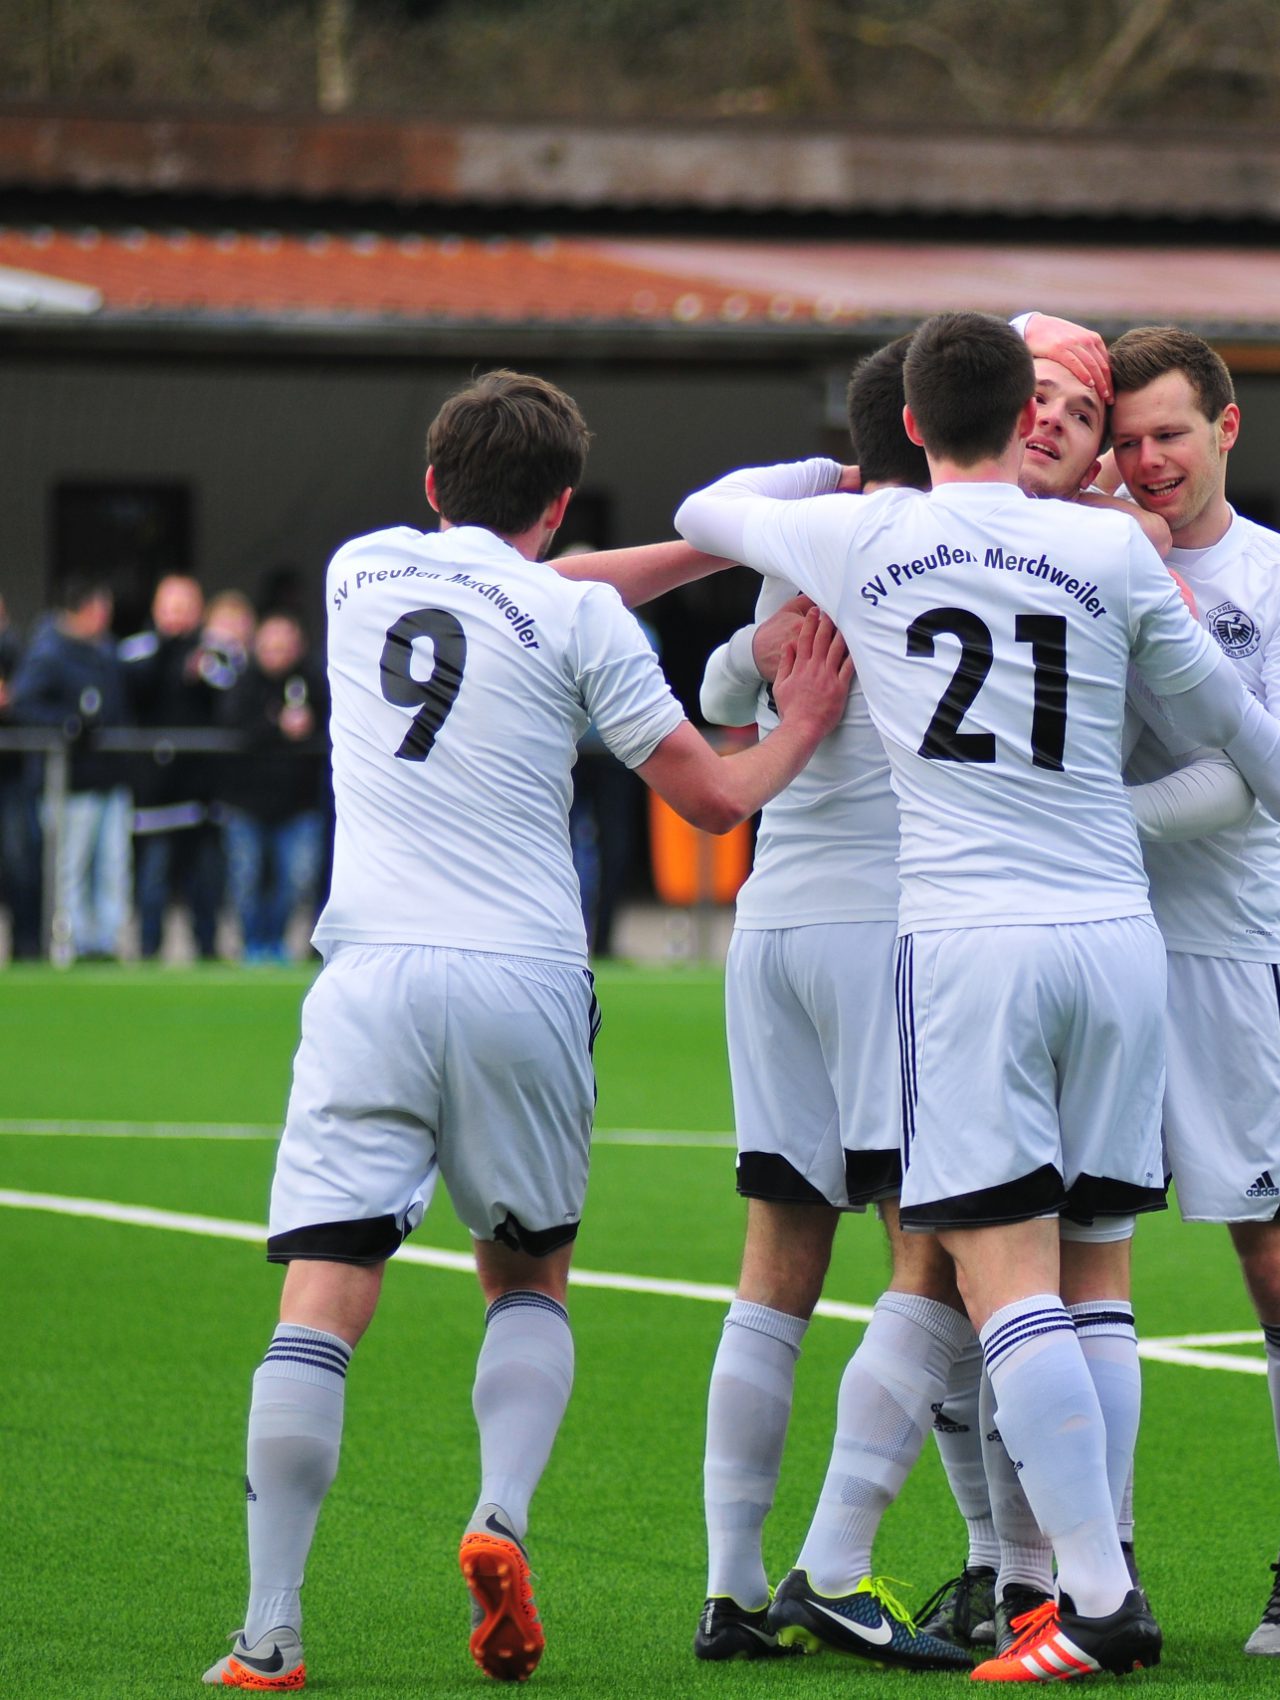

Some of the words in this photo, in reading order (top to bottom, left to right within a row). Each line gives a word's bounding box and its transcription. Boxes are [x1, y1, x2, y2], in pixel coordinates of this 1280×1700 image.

[333, 580, 349, 612] SV
[356, 566, 441, 589] Preußen
[446, 573, 541, 651] Merchweiler
[860, 574, 888, 607] SV
[984, 548, 1107, 619] Merchweiler
[379, 608, 468, 763] 9
[905, 606, 1069, 772] 21
[1246, 1186, 1280, 1197] adidas
